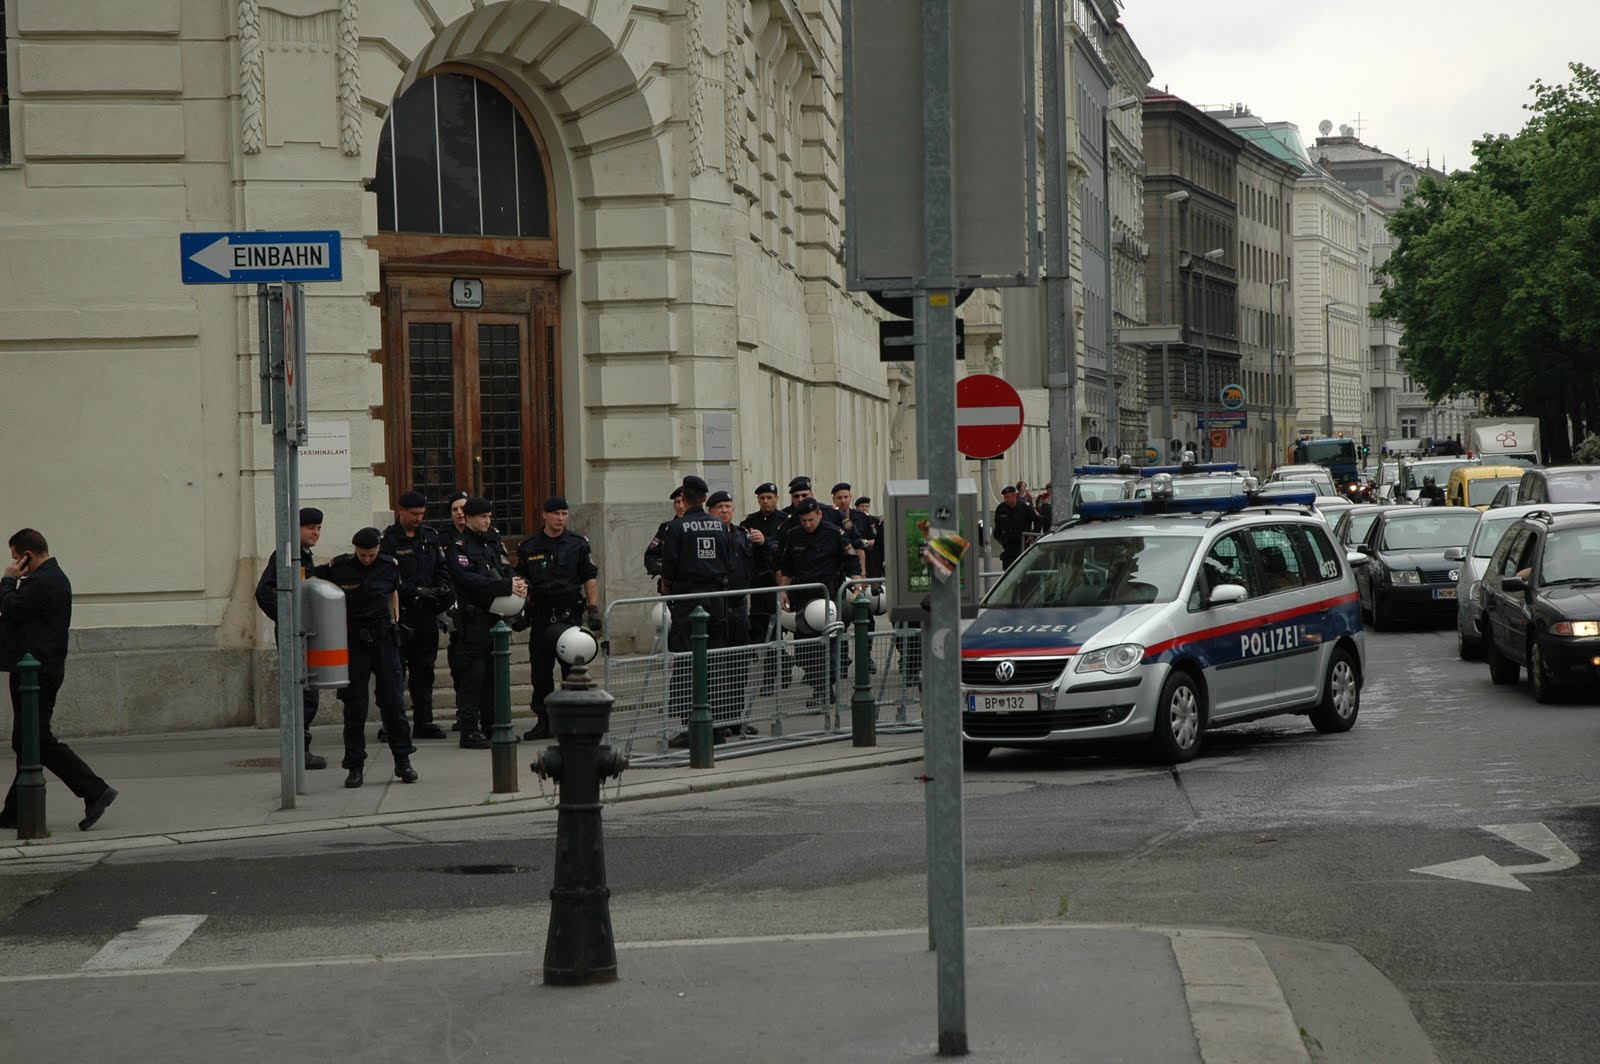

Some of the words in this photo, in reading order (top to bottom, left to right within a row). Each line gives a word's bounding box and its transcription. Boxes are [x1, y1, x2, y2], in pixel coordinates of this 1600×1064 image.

[234, 245, 322, 267] EINBAHN
[464, 281, 472, 299] 5
[682, 520, 723, 532] POLIZEI
[703, 540, 711, 549] D
[982, 625, 1077, 635] POLIZEI
[1241, 625, 1299, 657] POLIZEI
[985, 697, 998, 710] BP
[1006, 697, 1025, 709] 132
